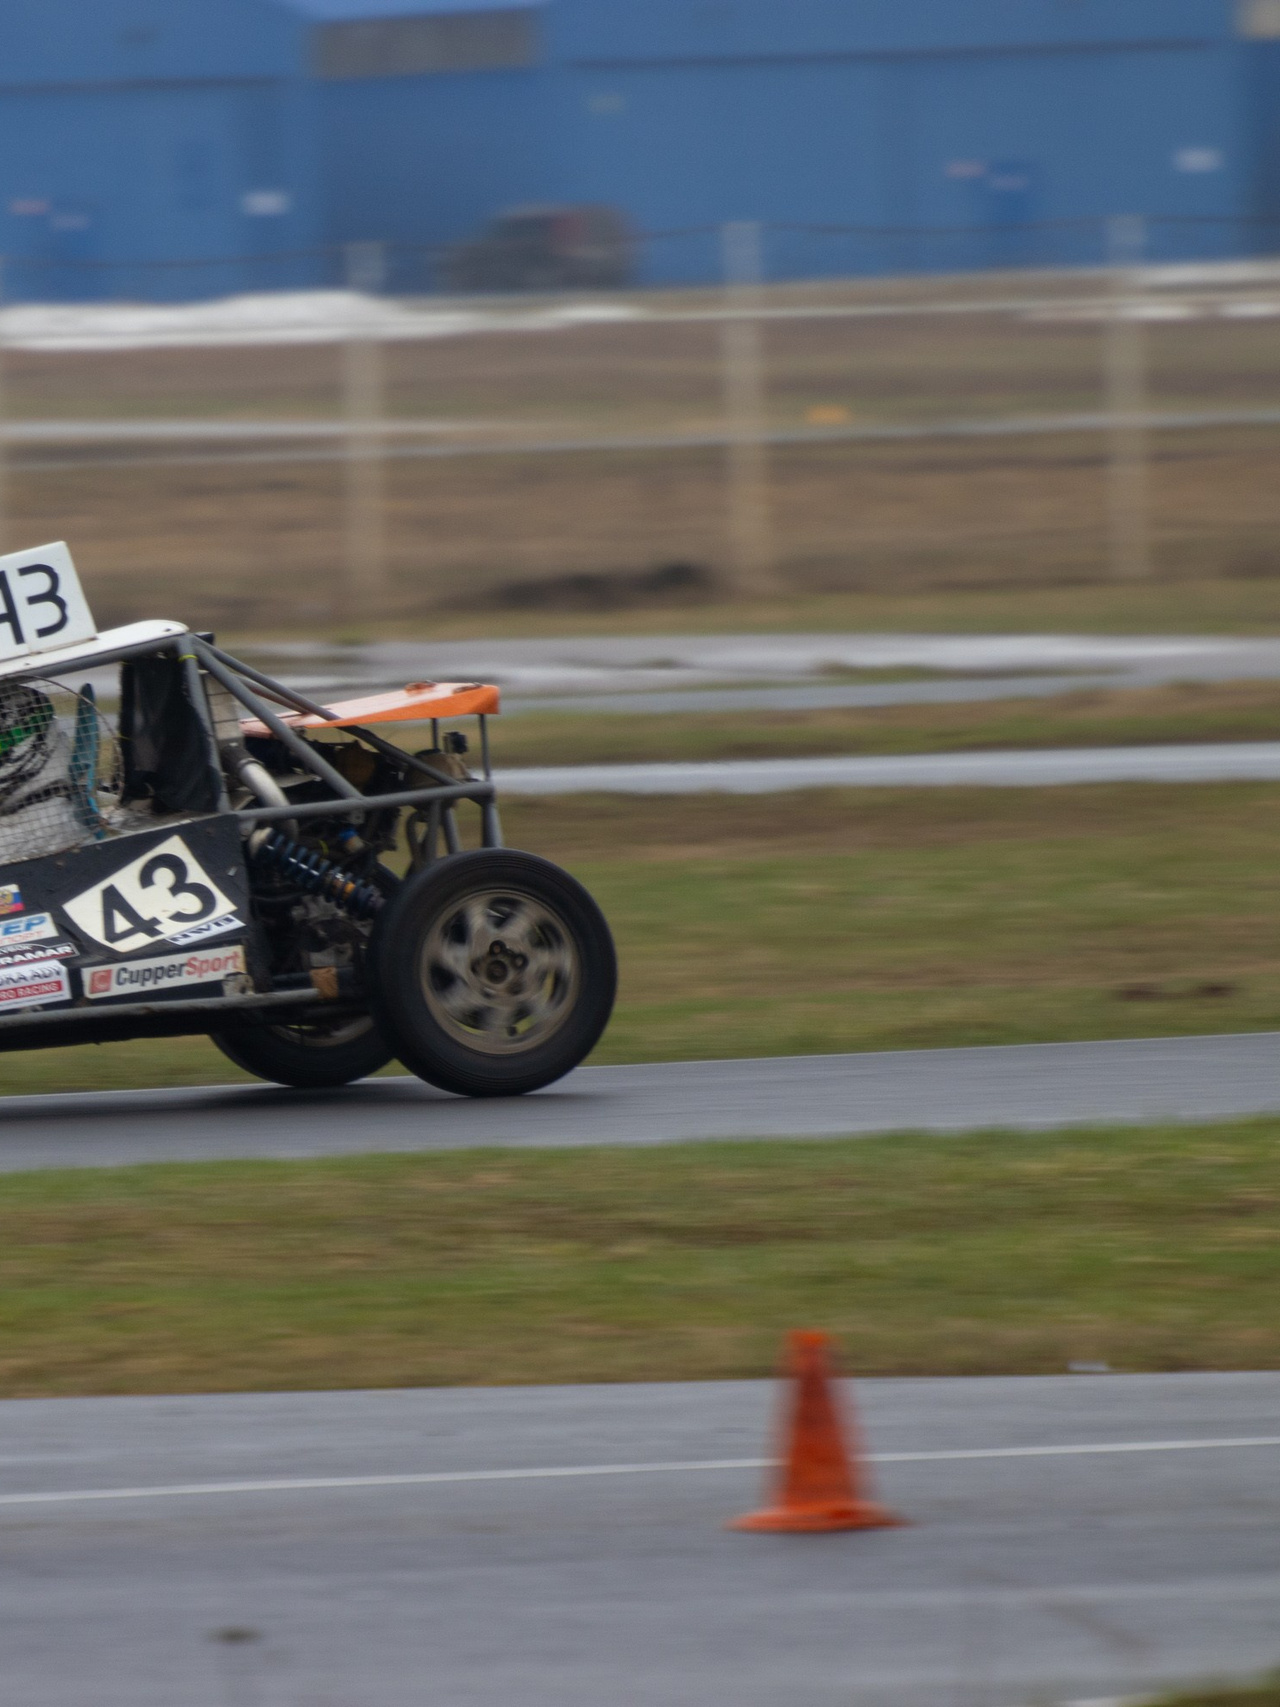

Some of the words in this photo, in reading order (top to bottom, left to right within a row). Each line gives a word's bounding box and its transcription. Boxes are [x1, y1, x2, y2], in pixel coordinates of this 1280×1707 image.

[102, 853, 217, 943] 43
[115, 951, 241, 986] CupperSport
[17, 983, 59, 997] RACING
